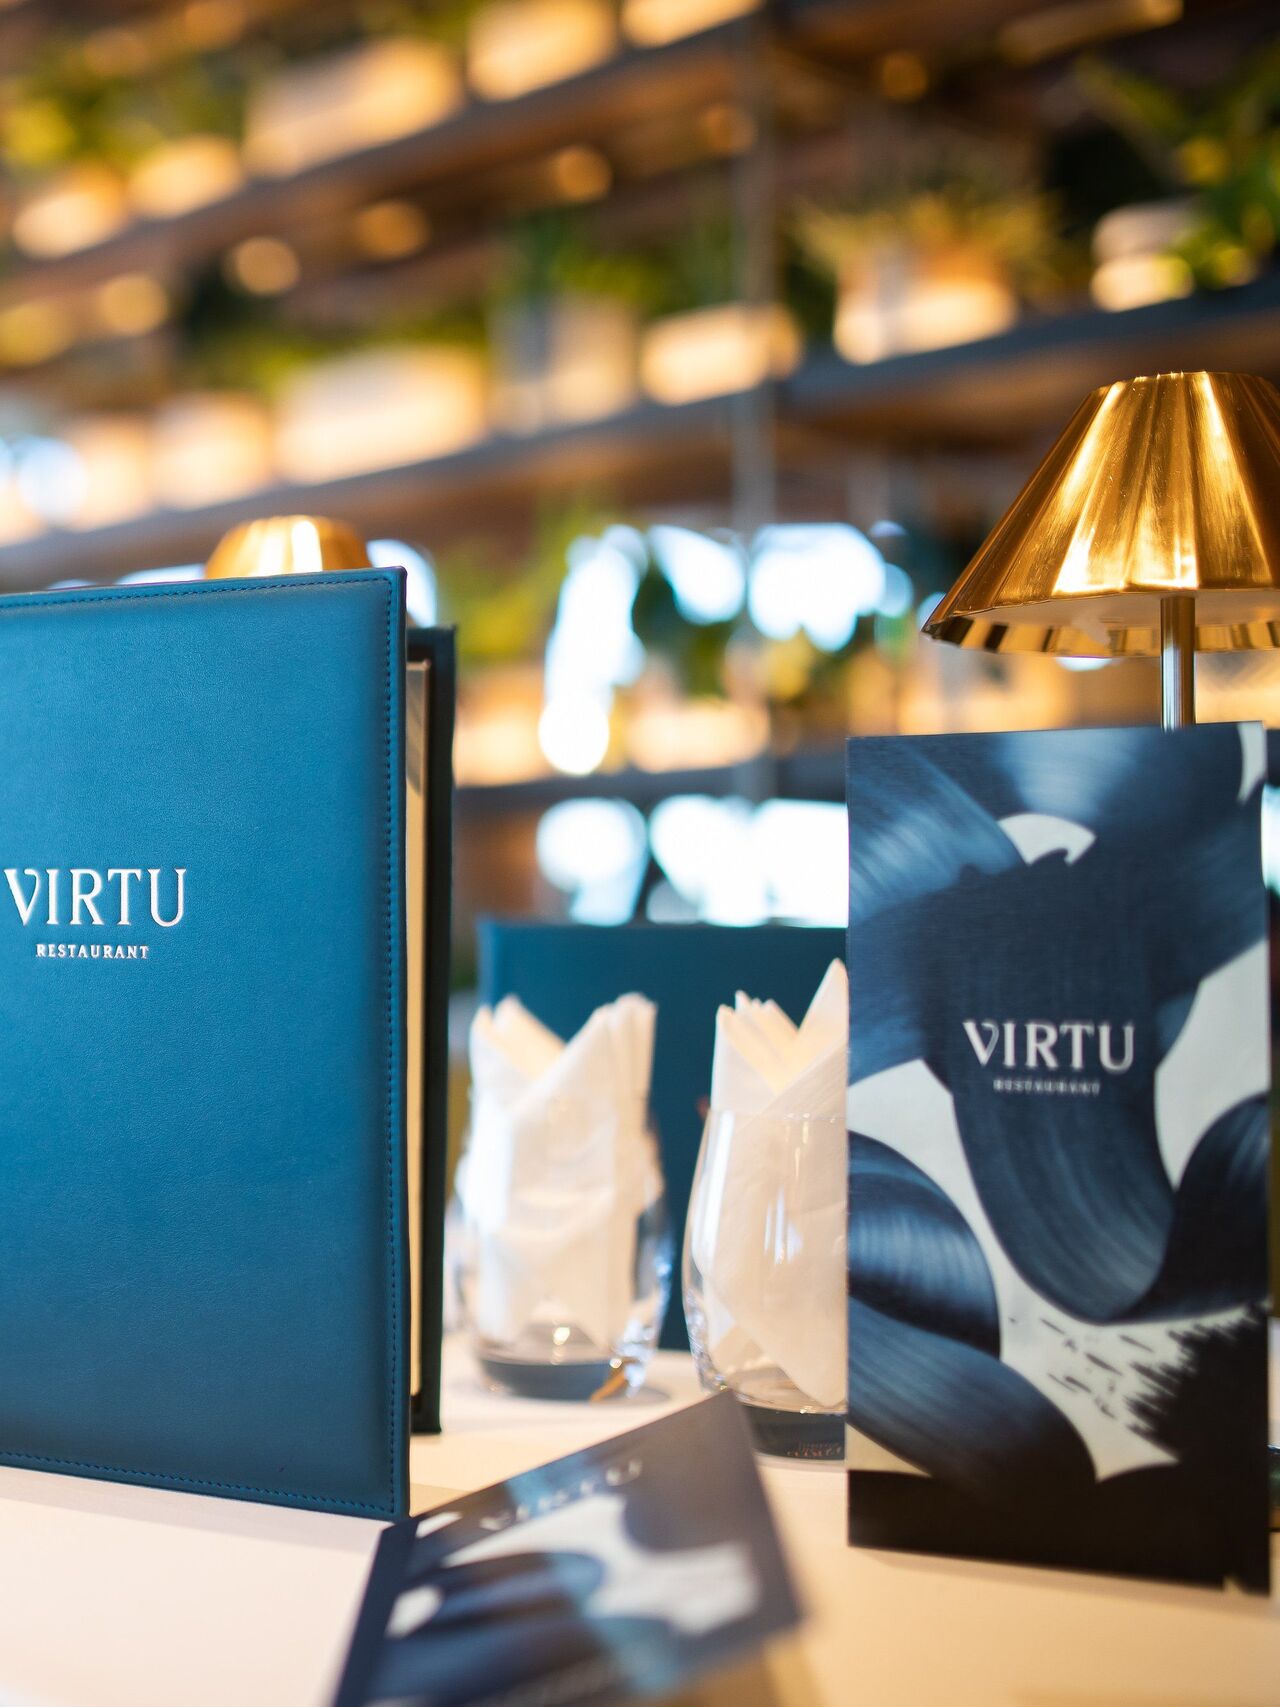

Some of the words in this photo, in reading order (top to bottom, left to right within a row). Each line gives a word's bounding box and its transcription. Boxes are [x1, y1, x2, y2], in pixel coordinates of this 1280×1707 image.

[3, 868, 187, 927] VIRTU
[36, 943, 150, 959] RESTAURANT
[962, 1020, 1135, 1074] VIRTU
